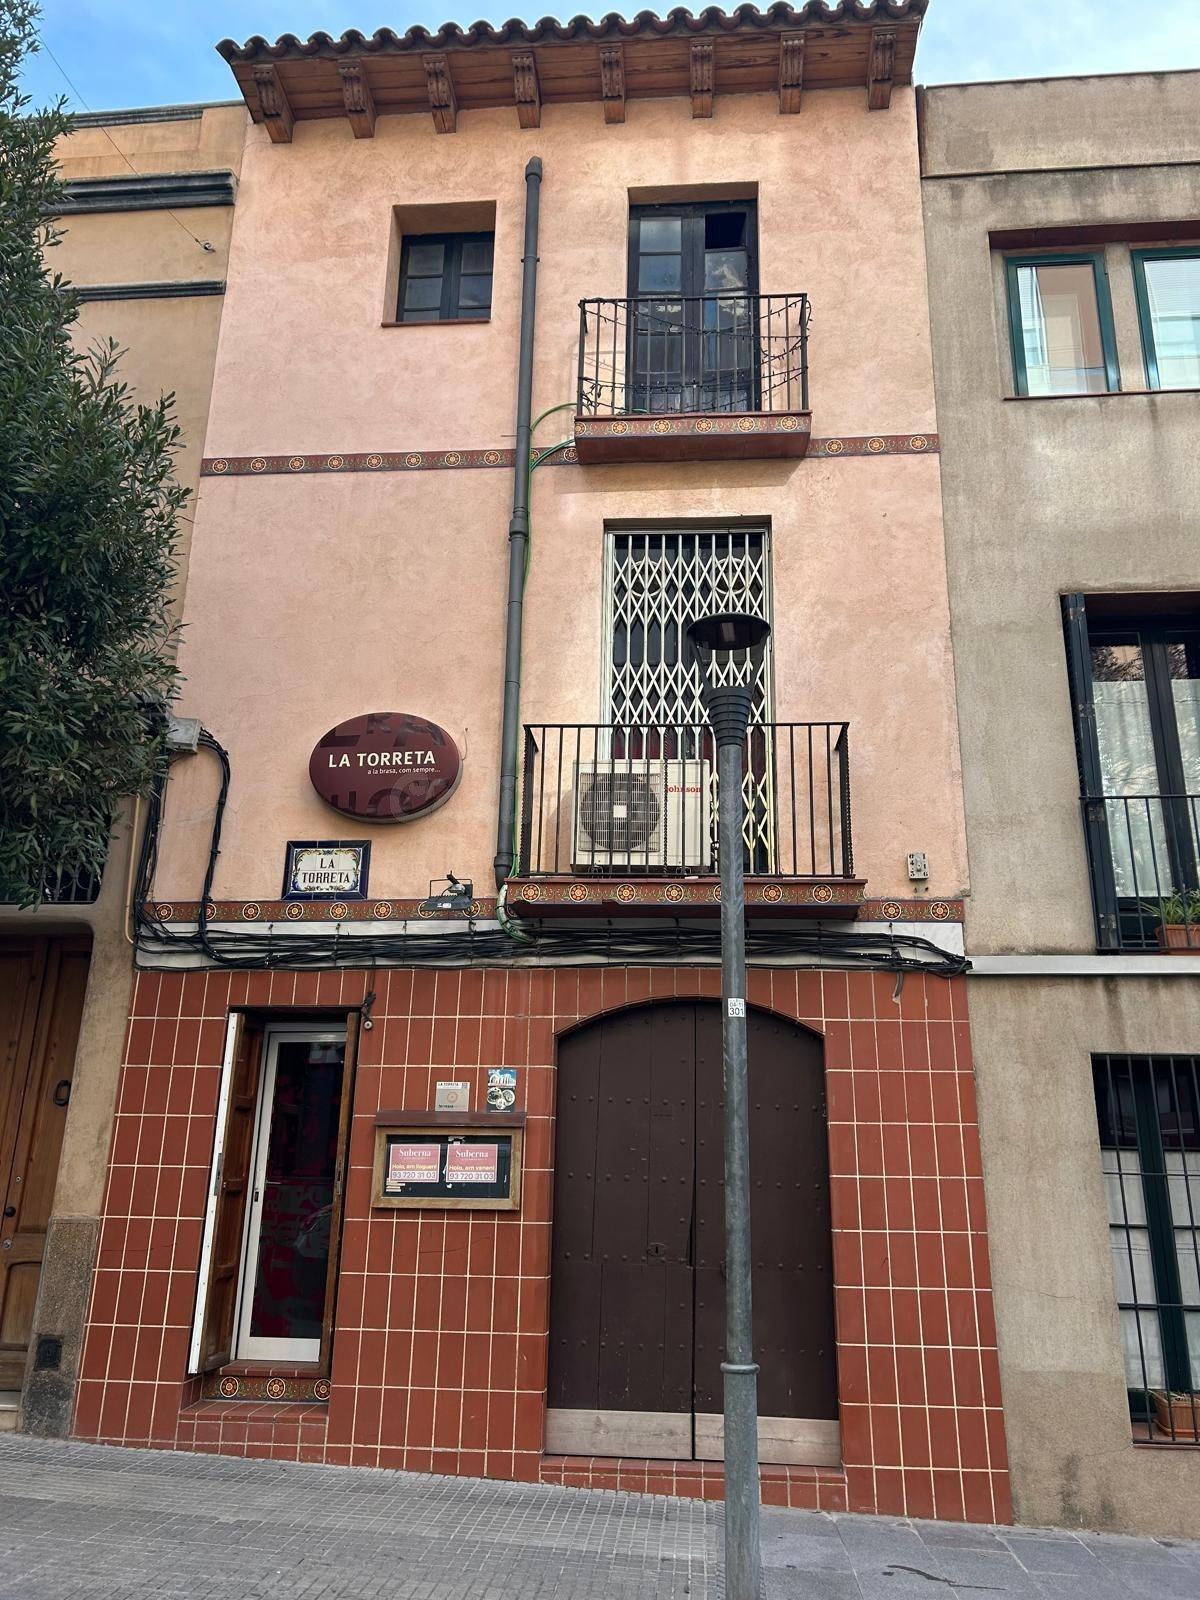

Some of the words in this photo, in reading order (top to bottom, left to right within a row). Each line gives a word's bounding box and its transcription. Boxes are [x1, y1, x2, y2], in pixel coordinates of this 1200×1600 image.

[328, 753, 351, 768] LA
[357, 750, 436, 767] TORRETA
[320, 857, 335, 869] LA
[301, 871, 350, 884] TORRETA
[730, 1008, 744, 1016] 301
[399, 1148, 432, 1157] Suberna
[455, 1149, 489, 1158] Suberna
[392, 1171, 402, 1179] 93
[402, 1171, 416, 1179] 720
[417, 1171, 425, 1179] 31
[426, 1171, 436, 1179] 03
[449, 1172, 459, 1180] 93
[460, 1172, 474, 1180] 720
[475, 1172, 483, 1180] 31
[484, 1172, 494, 1180] 03
